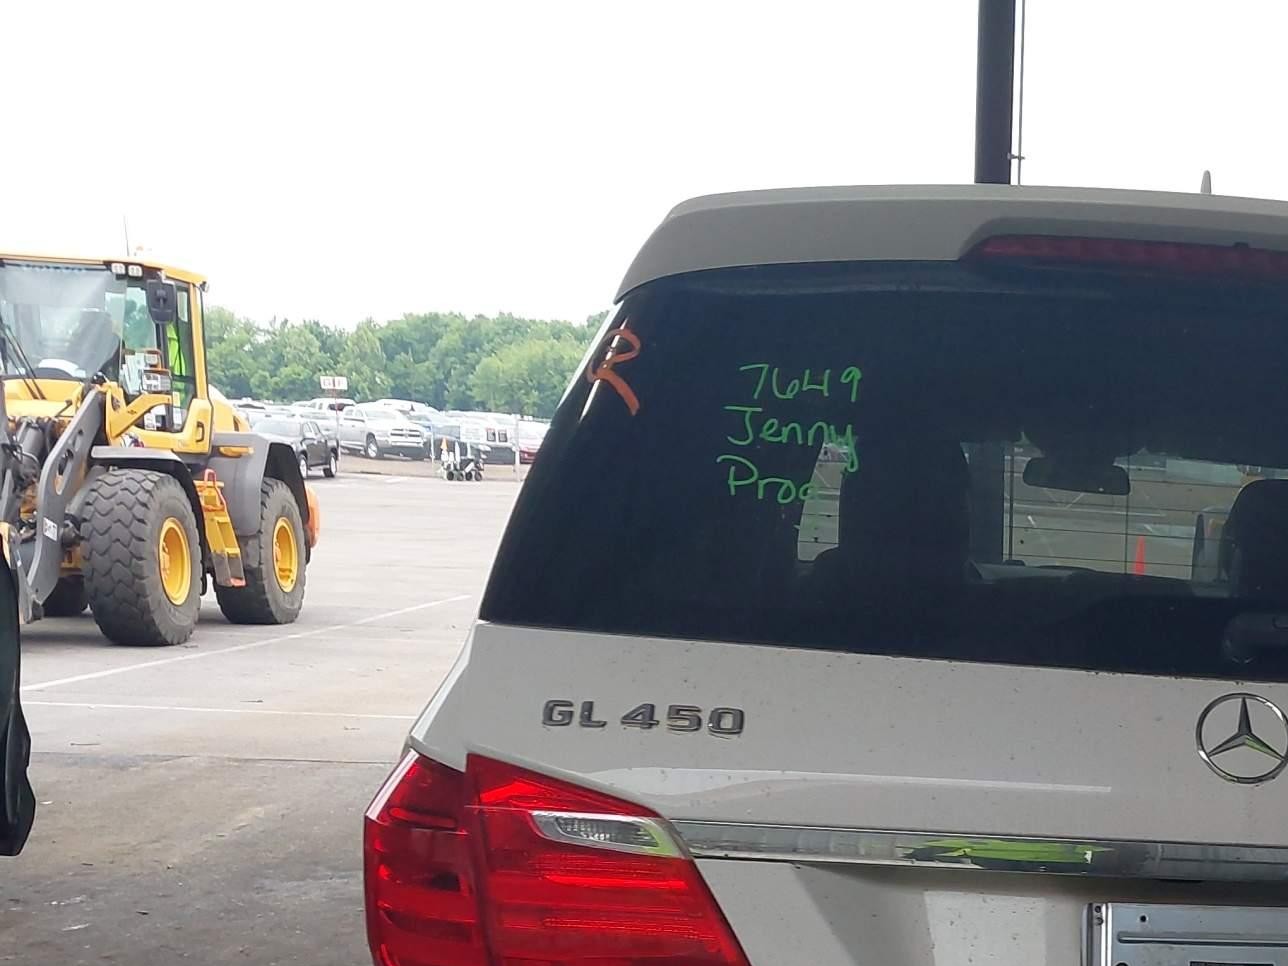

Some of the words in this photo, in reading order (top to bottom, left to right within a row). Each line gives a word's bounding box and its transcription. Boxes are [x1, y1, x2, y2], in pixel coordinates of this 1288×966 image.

[587, 328, 641, 416] R
[739, 363, 862, 402] 7649
[724, 404, 860, 473] Jenny
[542, 699, 608, 729] GL
[620, 703, 745, 736] 450
